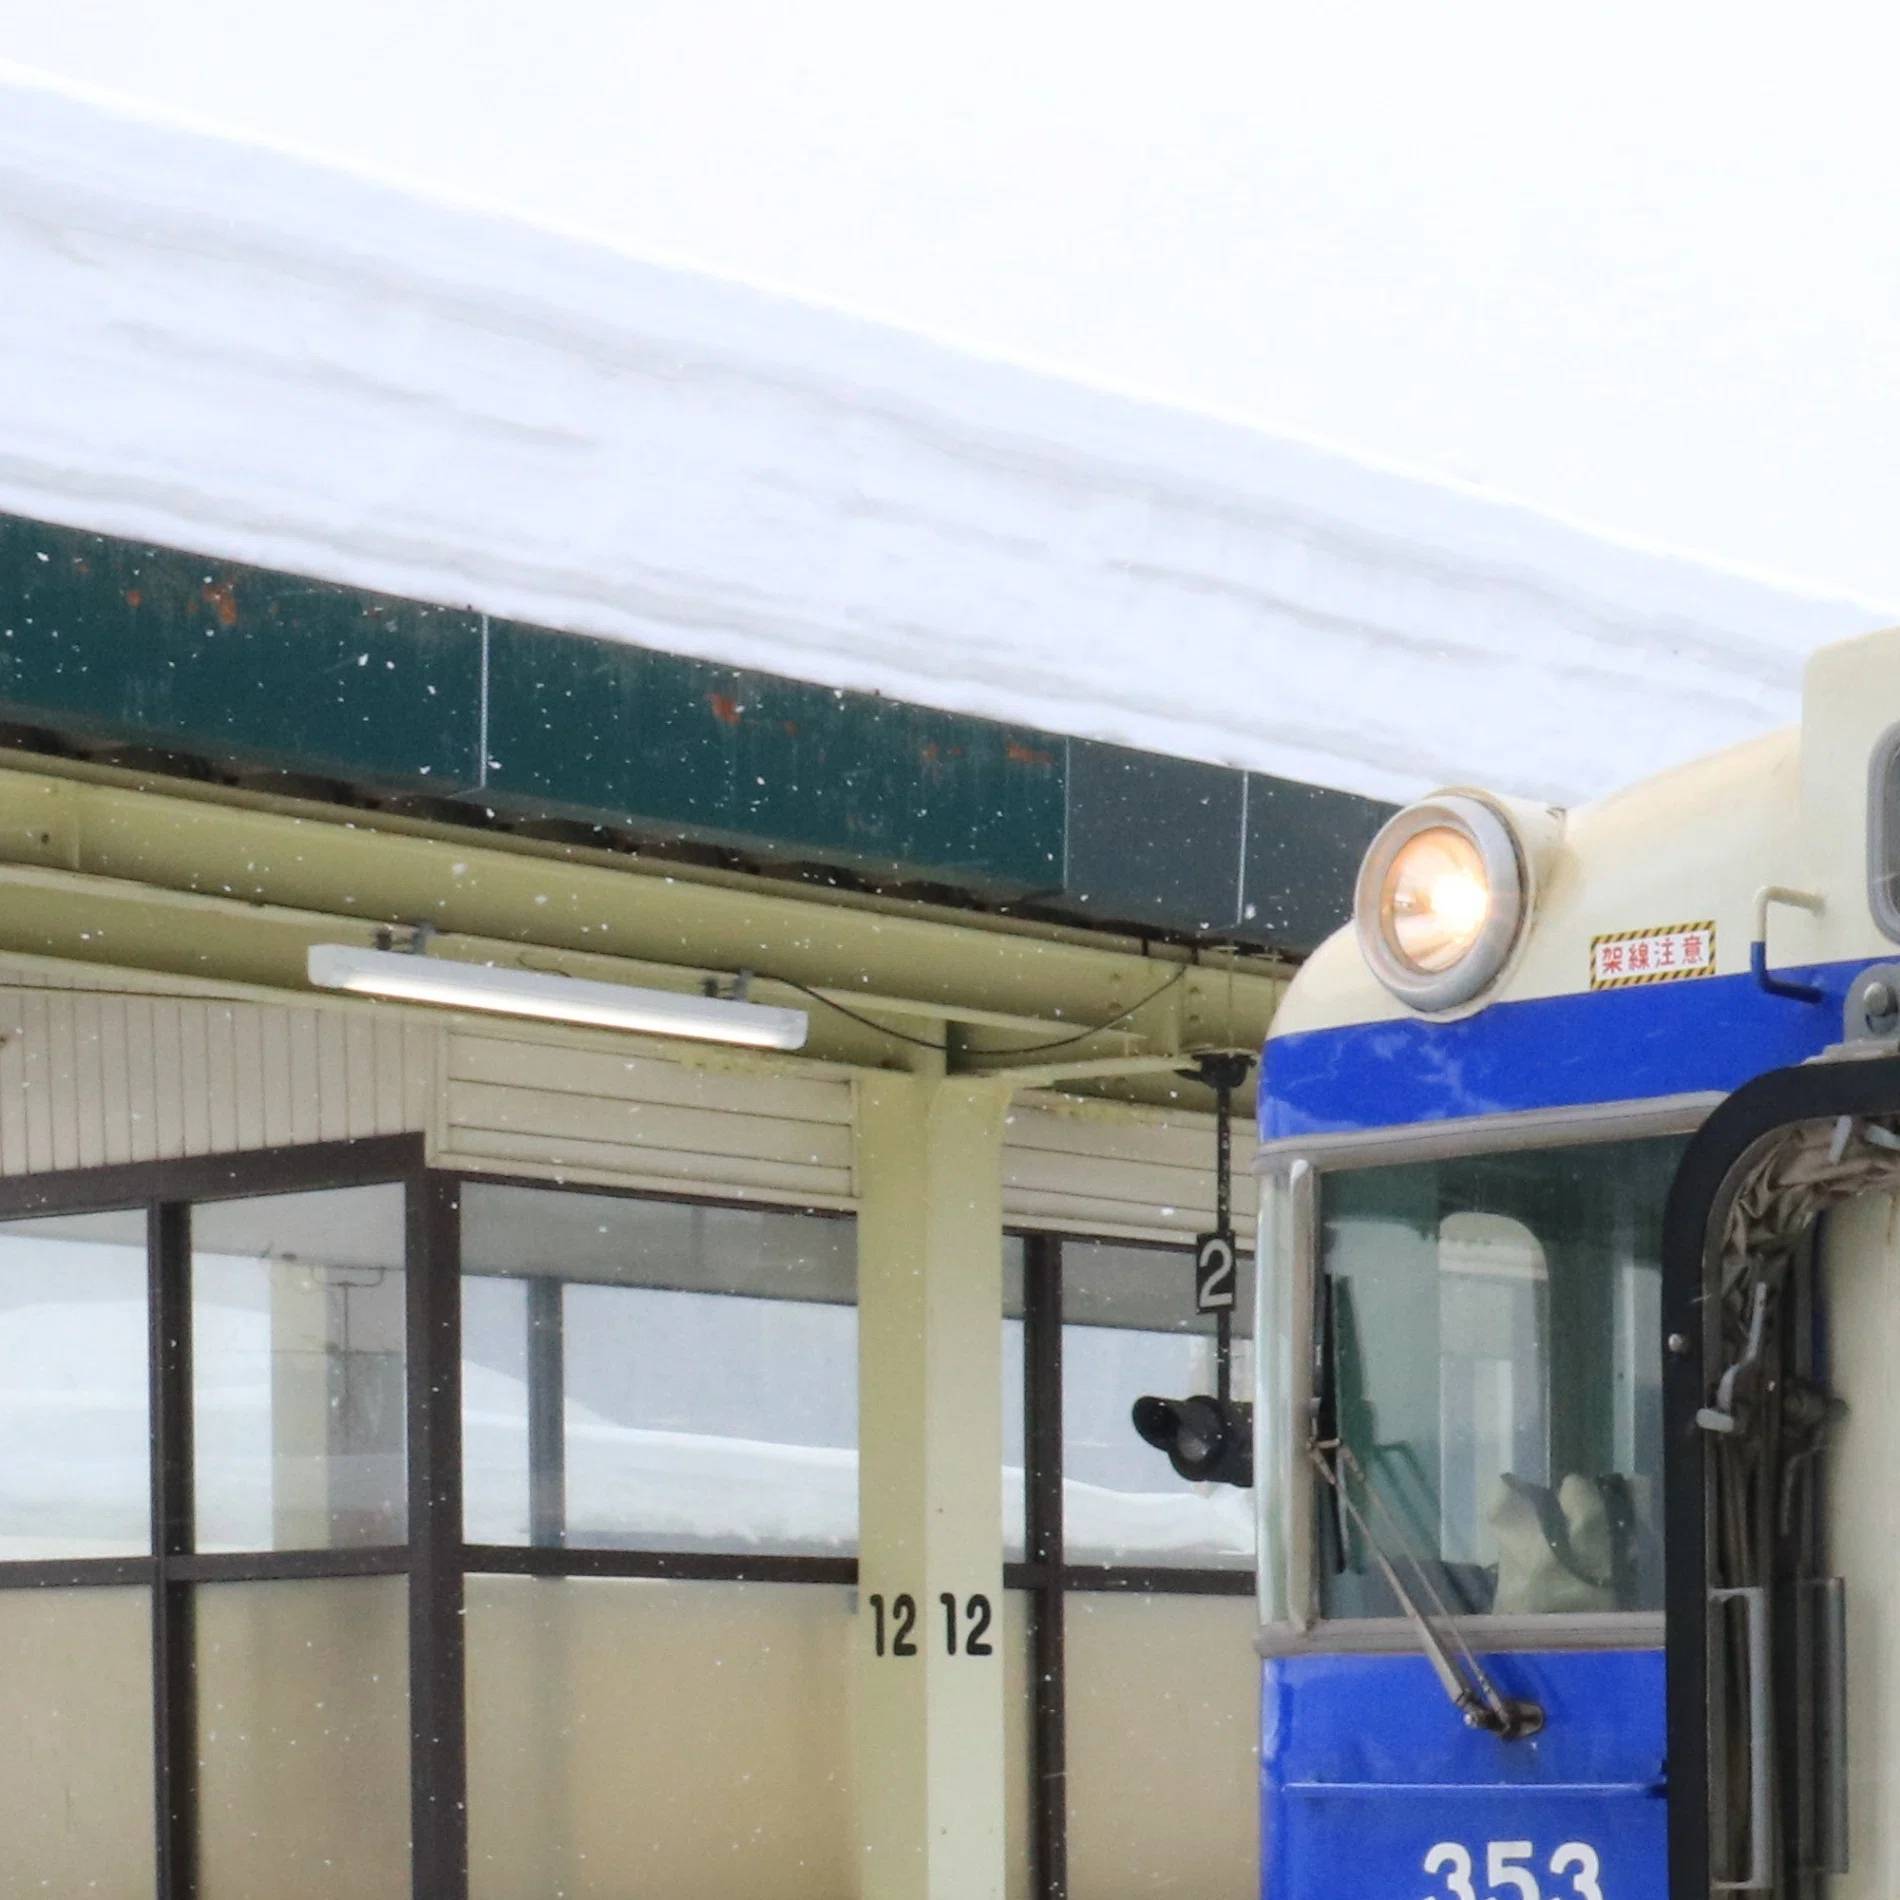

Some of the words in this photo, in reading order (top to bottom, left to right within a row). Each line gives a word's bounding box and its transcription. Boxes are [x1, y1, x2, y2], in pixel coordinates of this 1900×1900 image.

[1601, 933, 1704, 975] 架線注意
[1198, 1238, 1233, 1308] 2
[869, 1593, 918, 1657] 12
[940, 1592, 993, 1656] 12
